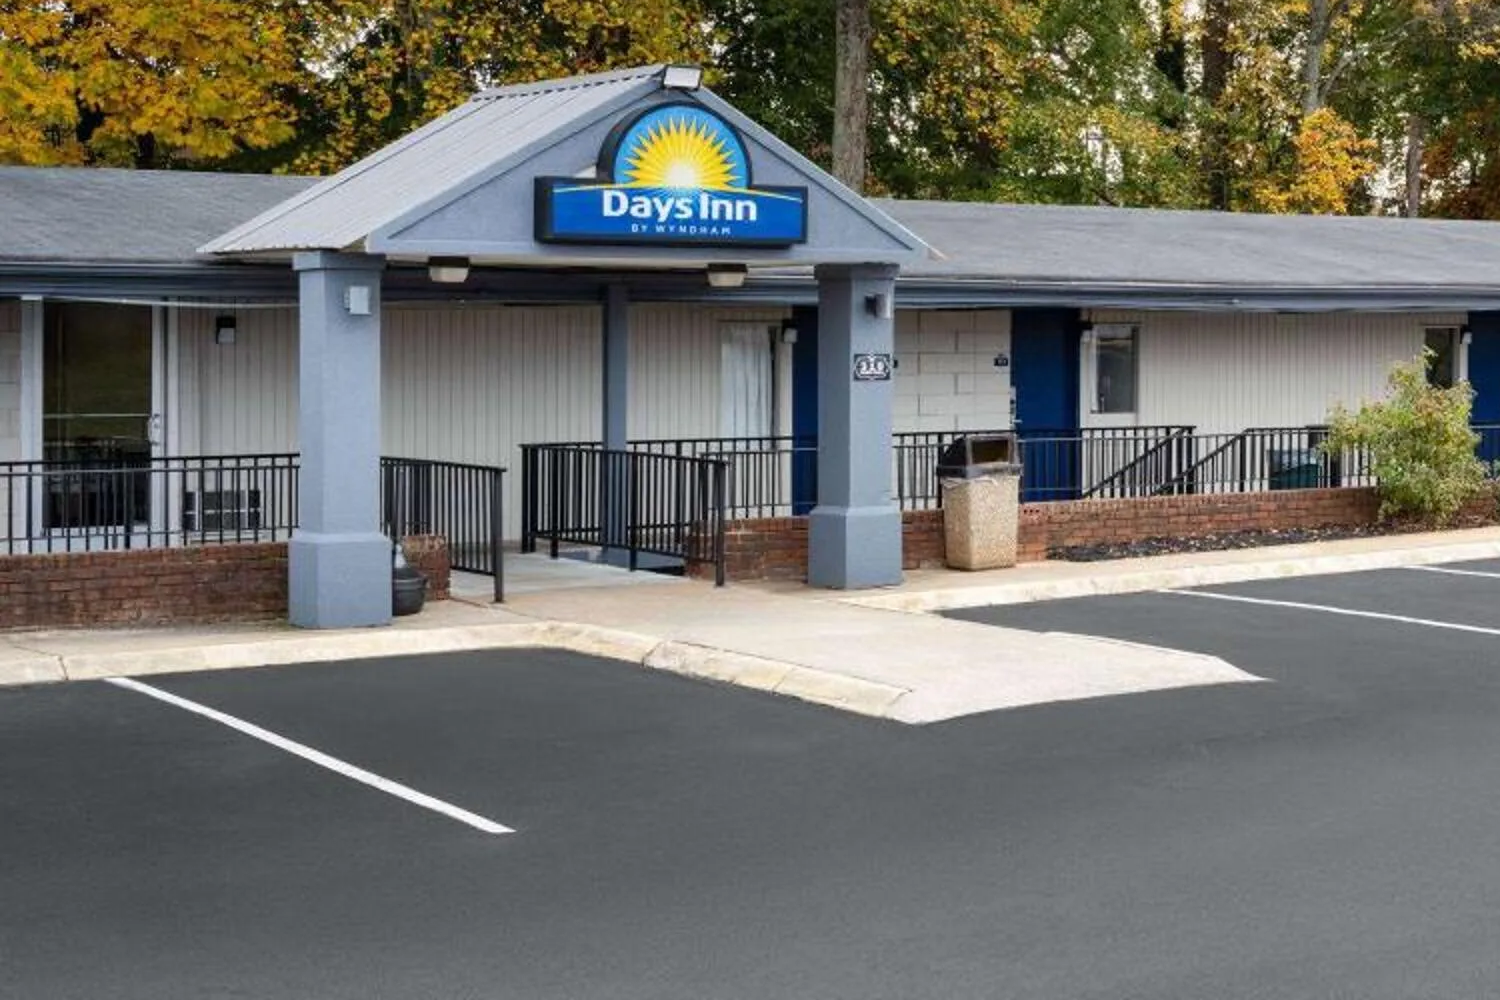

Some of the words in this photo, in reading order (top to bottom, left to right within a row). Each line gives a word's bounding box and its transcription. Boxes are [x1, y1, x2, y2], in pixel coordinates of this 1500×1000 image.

[602, 190, 693, 222] Days
[700, 191, 757, 221] Inn
[631, 223, 648, 233] BY
[656, 224, 732, 236] WYNDHAM
